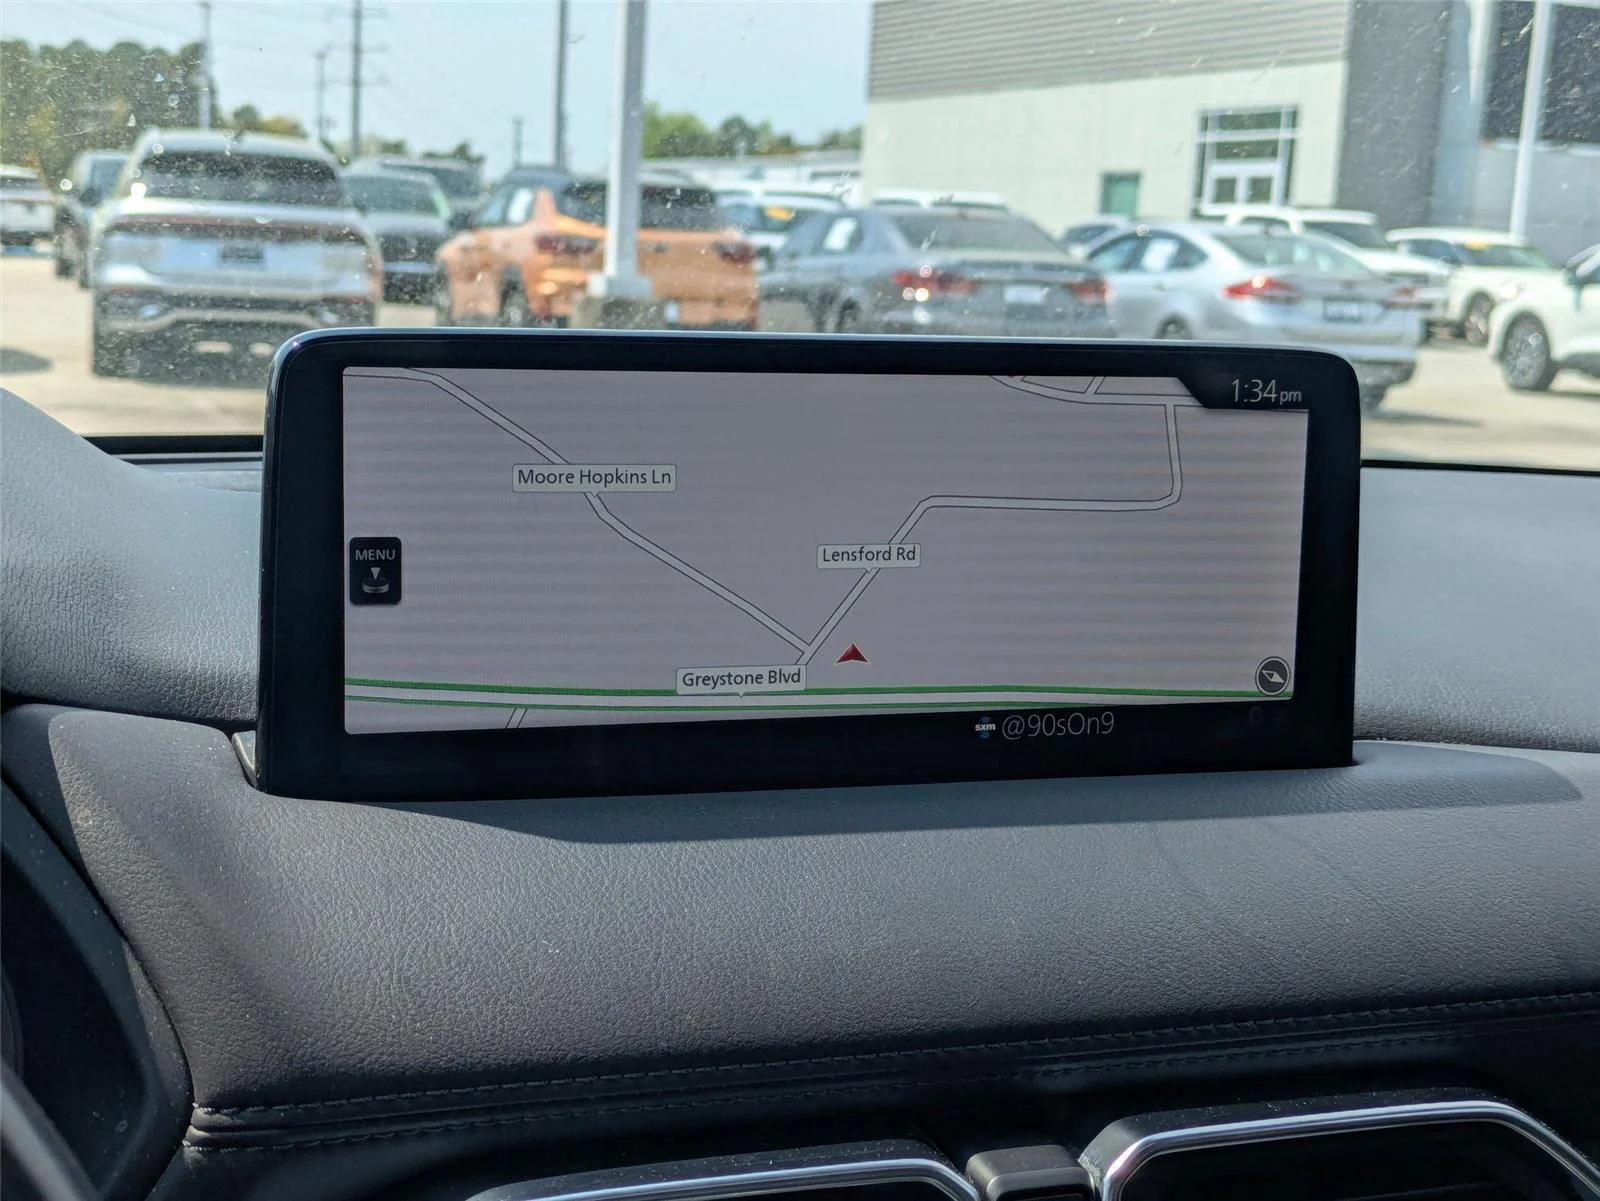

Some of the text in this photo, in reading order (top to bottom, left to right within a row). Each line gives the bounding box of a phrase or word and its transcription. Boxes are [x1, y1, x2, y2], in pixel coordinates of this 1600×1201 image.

[1231, 378, 1302, 405] 1:34 pm
[517, 467, 671, 488] Moore Hopkins Ln
[355, 549, 396, 561] MENU
[822, 544, 916, 562] Lensford Rd
[681, 667, 801, 690] Greystone Blvd
[975, 711, 1115, 740] sxm @90sOn9
